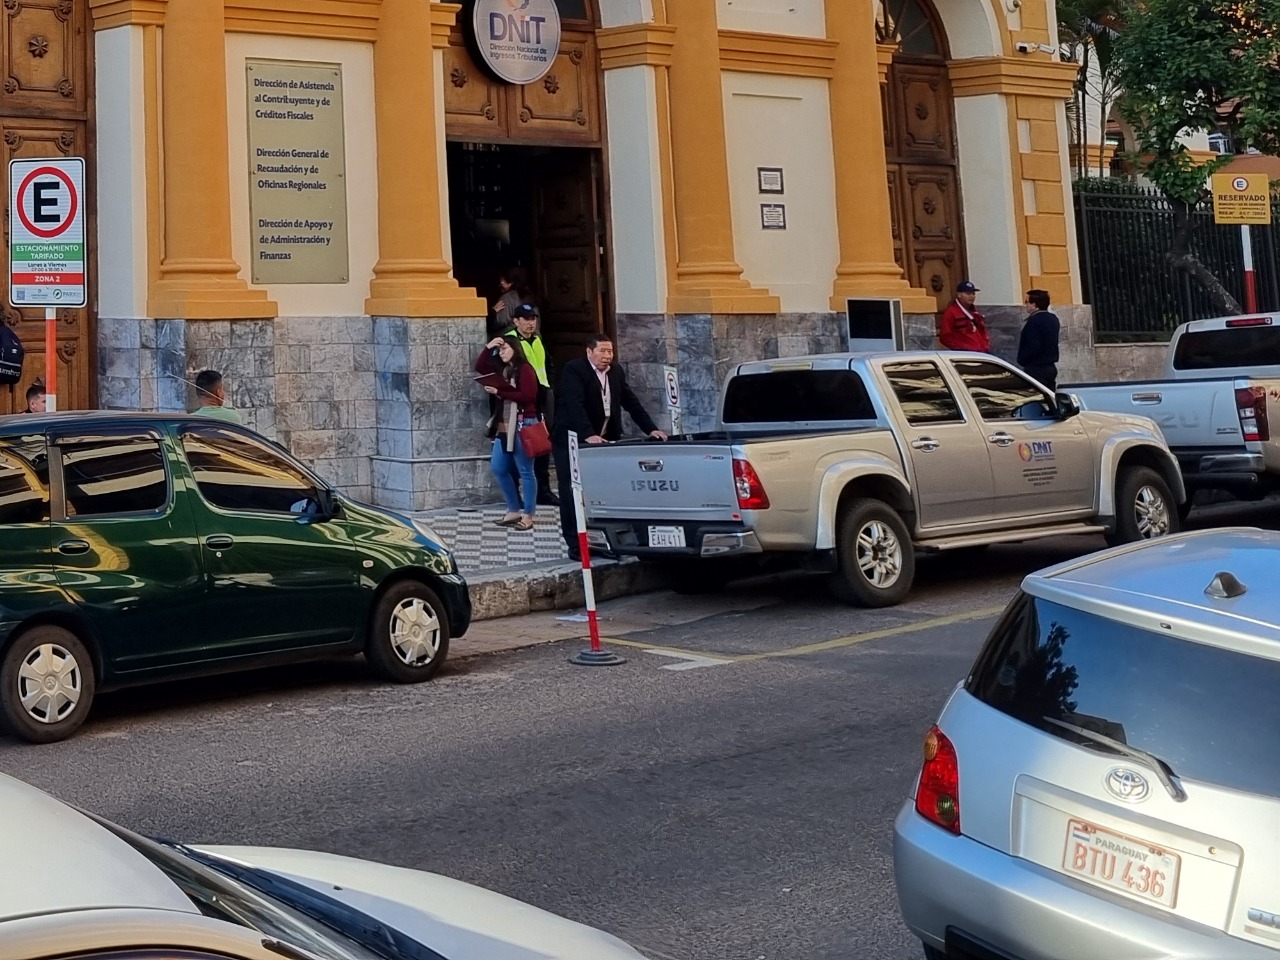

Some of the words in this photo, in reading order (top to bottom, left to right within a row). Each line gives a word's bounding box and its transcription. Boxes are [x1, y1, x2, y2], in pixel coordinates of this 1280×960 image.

[490, 43, 515, 51] Dirección
[490, 52, 515, 60] Ingresos
[517, 53, 547, 62] Tributarios
[254, 79, 288, 88] Dirección
[289, 81, 298, 89] de
[299, 81, 335, 91] Asistencia
[255, 94, 261, 103] al
[262, 95, 315, 106] Contribuyente
[316, 99, 321, 107] y
[321, 98, 331, 106] de
[256, 109, 286, 119] Créditos
[287, 112, 314, 121] Fiscales
[257, 148, 290, 158] Dirección
[292, 150, 319, 158] General
[320, 151, 329, 159] de
[257, 164, 303, 173] Recaudación
[304, 167, 309, 175] y
[310, 166, 319, 174] de
[258, 180, 288, 189] Oficinas
[288, 181, 326, 192] Regionales
[33, 182, 60, 223] E
[259, 219, 293, 228] Dirección
[294, 220, 303, 228] de
[304, 220, 328, 231] Apoyo
[328, 222, 333, 231] y
[260, 235, 269, 244] de
[270, 235, 325, 244] Administración
[325, 237, 331, 246] y
[260, 251, 292, 260] Finanzas
[631, 480, 680, 492] ISUZU
[1095, 837, 1149, 861] PARAGUAY
[1072, 842, 1117, 881] BTU
[1121, 860, 1166, 898] 436
